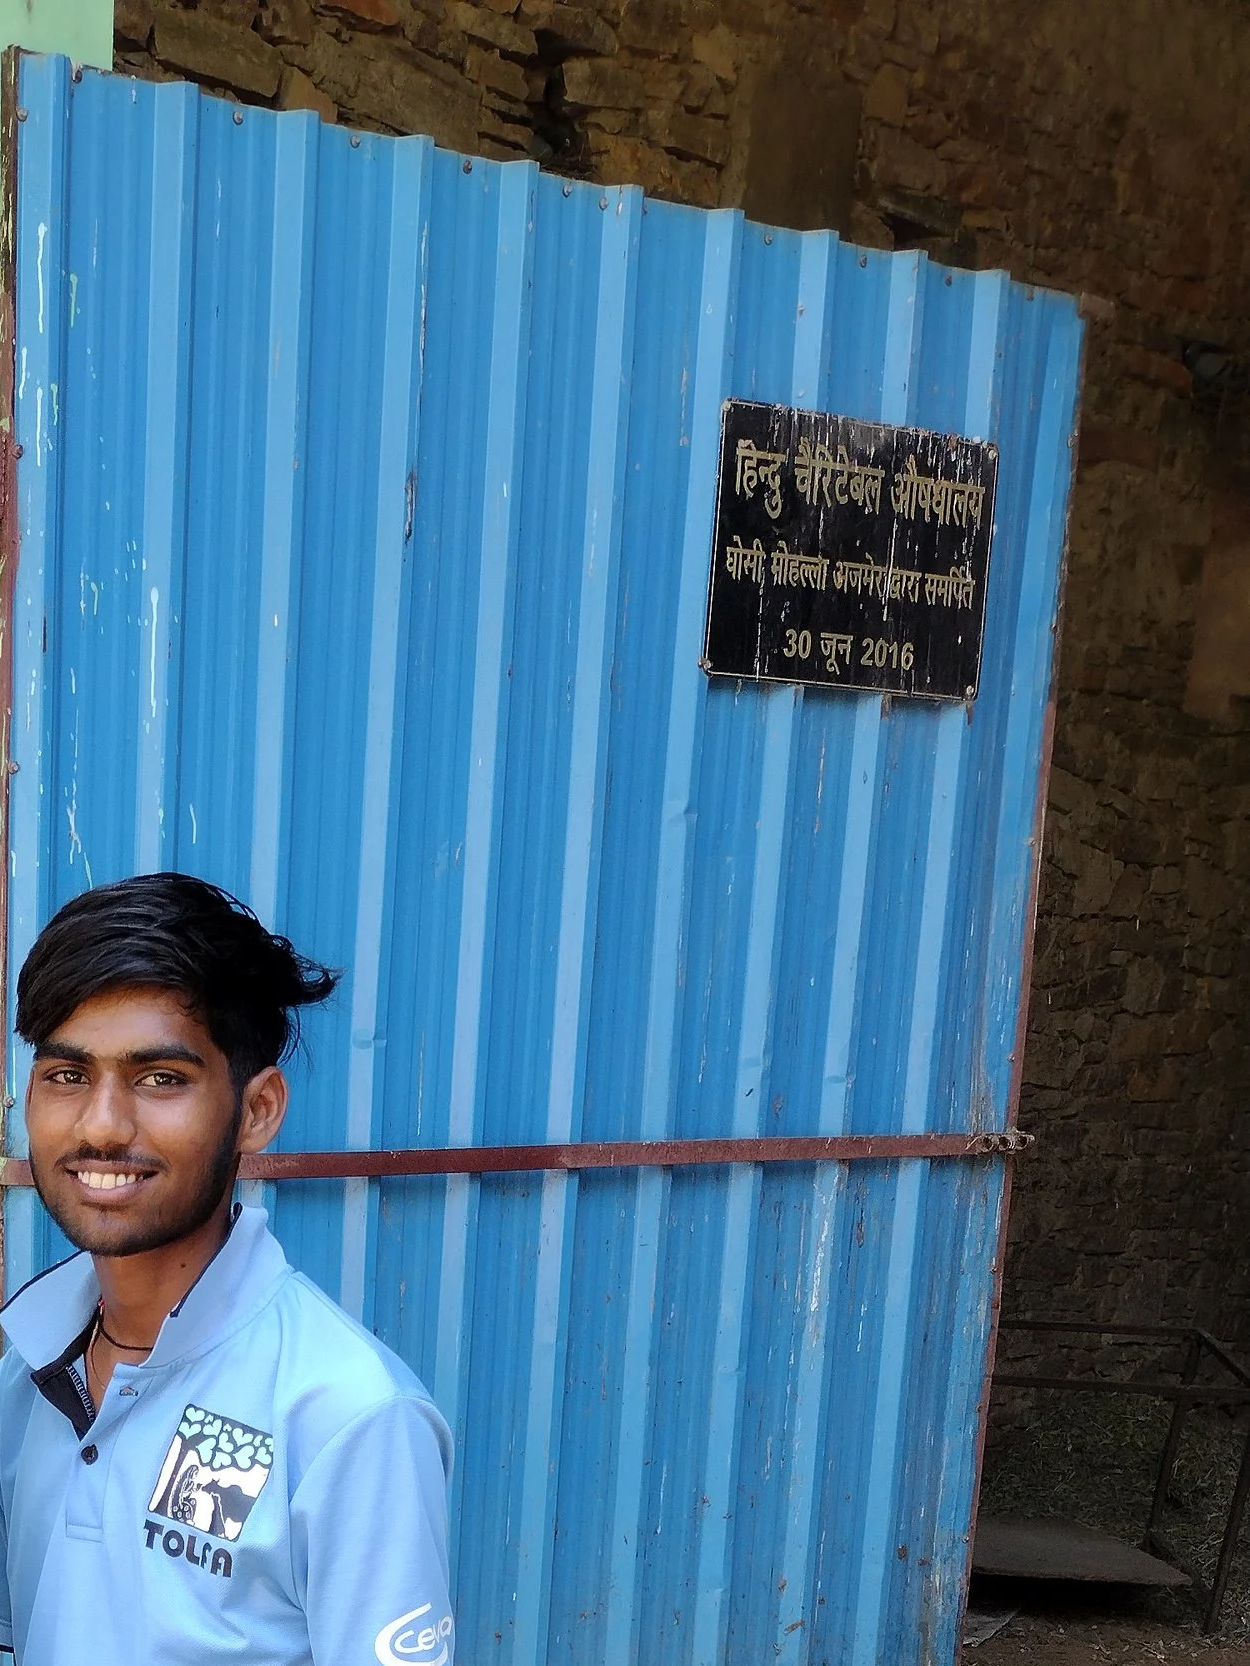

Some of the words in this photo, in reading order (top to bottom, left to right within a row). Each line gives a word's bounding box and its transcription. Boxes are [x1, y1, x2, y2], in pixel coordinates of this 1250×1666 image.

[891, 454, 986, 529] औषधालय
[783, 628, 812, 659] 30
[820, 632, 854, 675] जून
[860, 638, 914, 671] 2016
